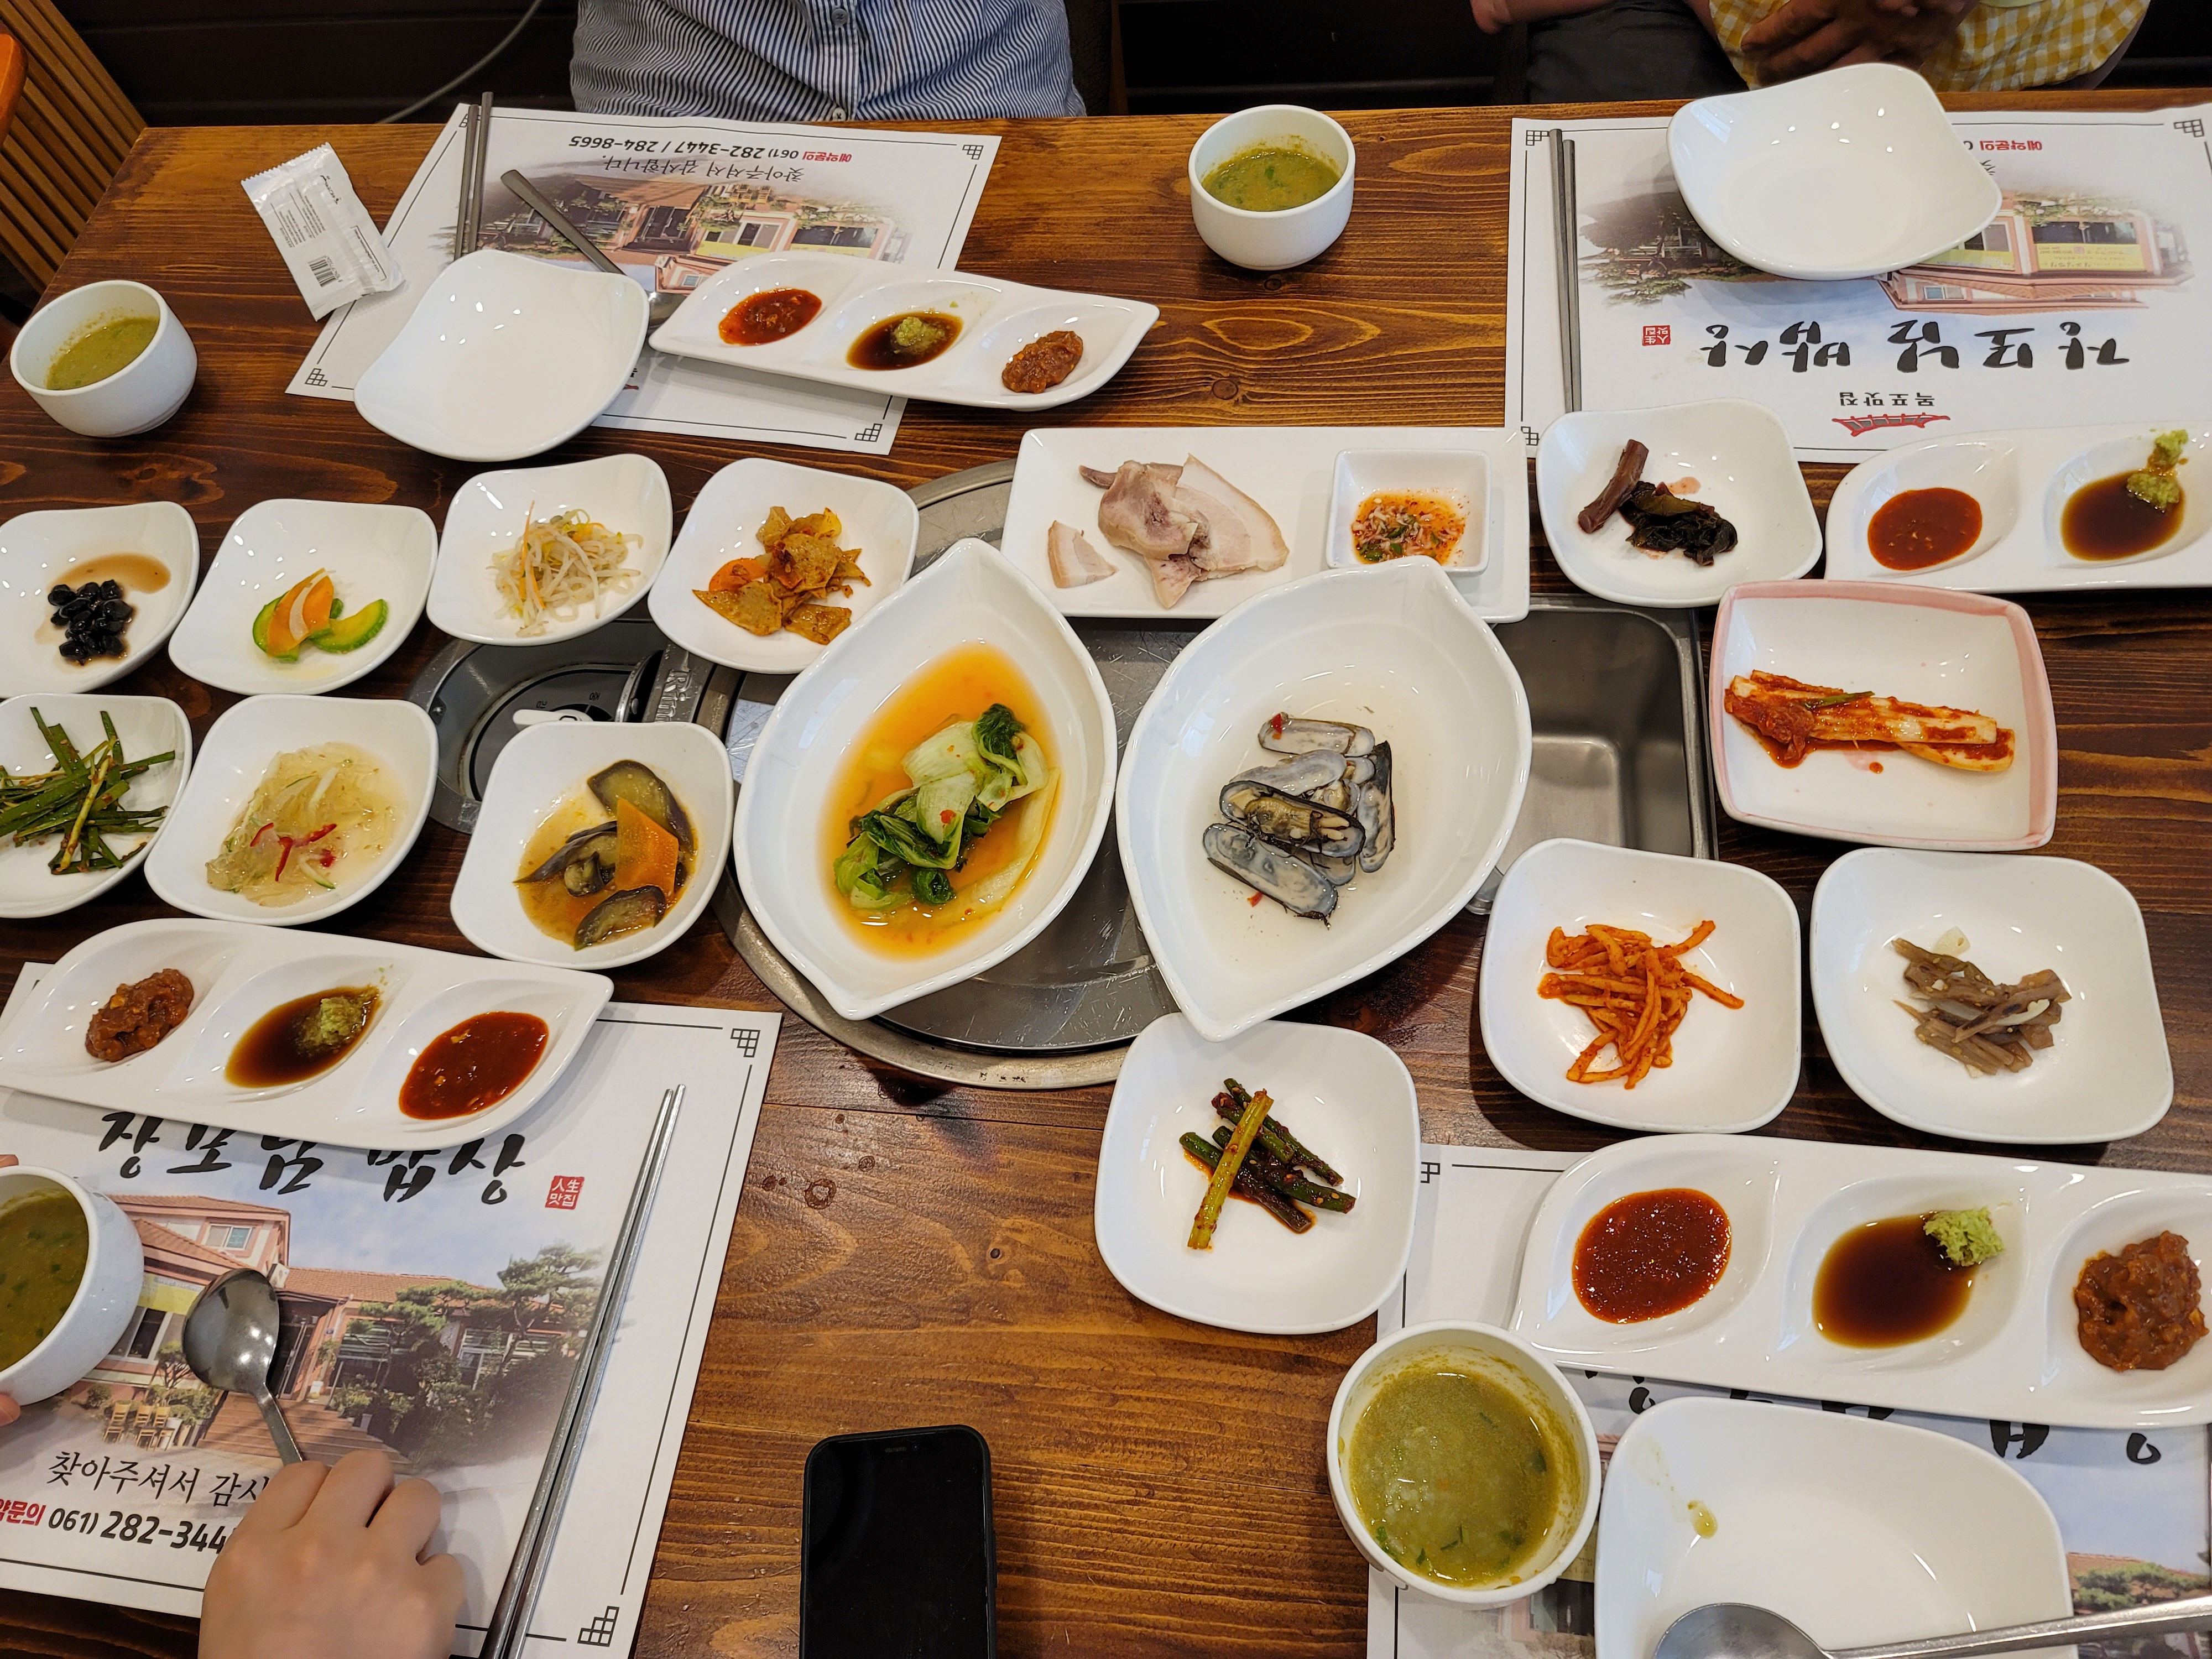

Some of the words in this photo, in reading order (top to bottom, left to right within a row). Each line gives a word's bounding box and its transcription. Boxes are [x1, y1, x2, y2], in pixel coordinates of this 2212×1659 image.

[568, 135, 658, 153] 284-8665
[674, 141, 765, 159] 282-3447
[1979, 140, 2043, 151] 예약문의
[768, 148, 799, 159] 061)
[802, 150, 852, 162] 예약문의
[602, 154, 699, 175] 감사합니다.
[706, 163, 805, 181] 찾아주셔서
[549, 1193, 576, 1207] 맛집
[46, 1451, 200, 1504] 찾아주셔서
[48, 1507, 99, 1535] 061)
[100, 1511, 236, 1554] 282-344
